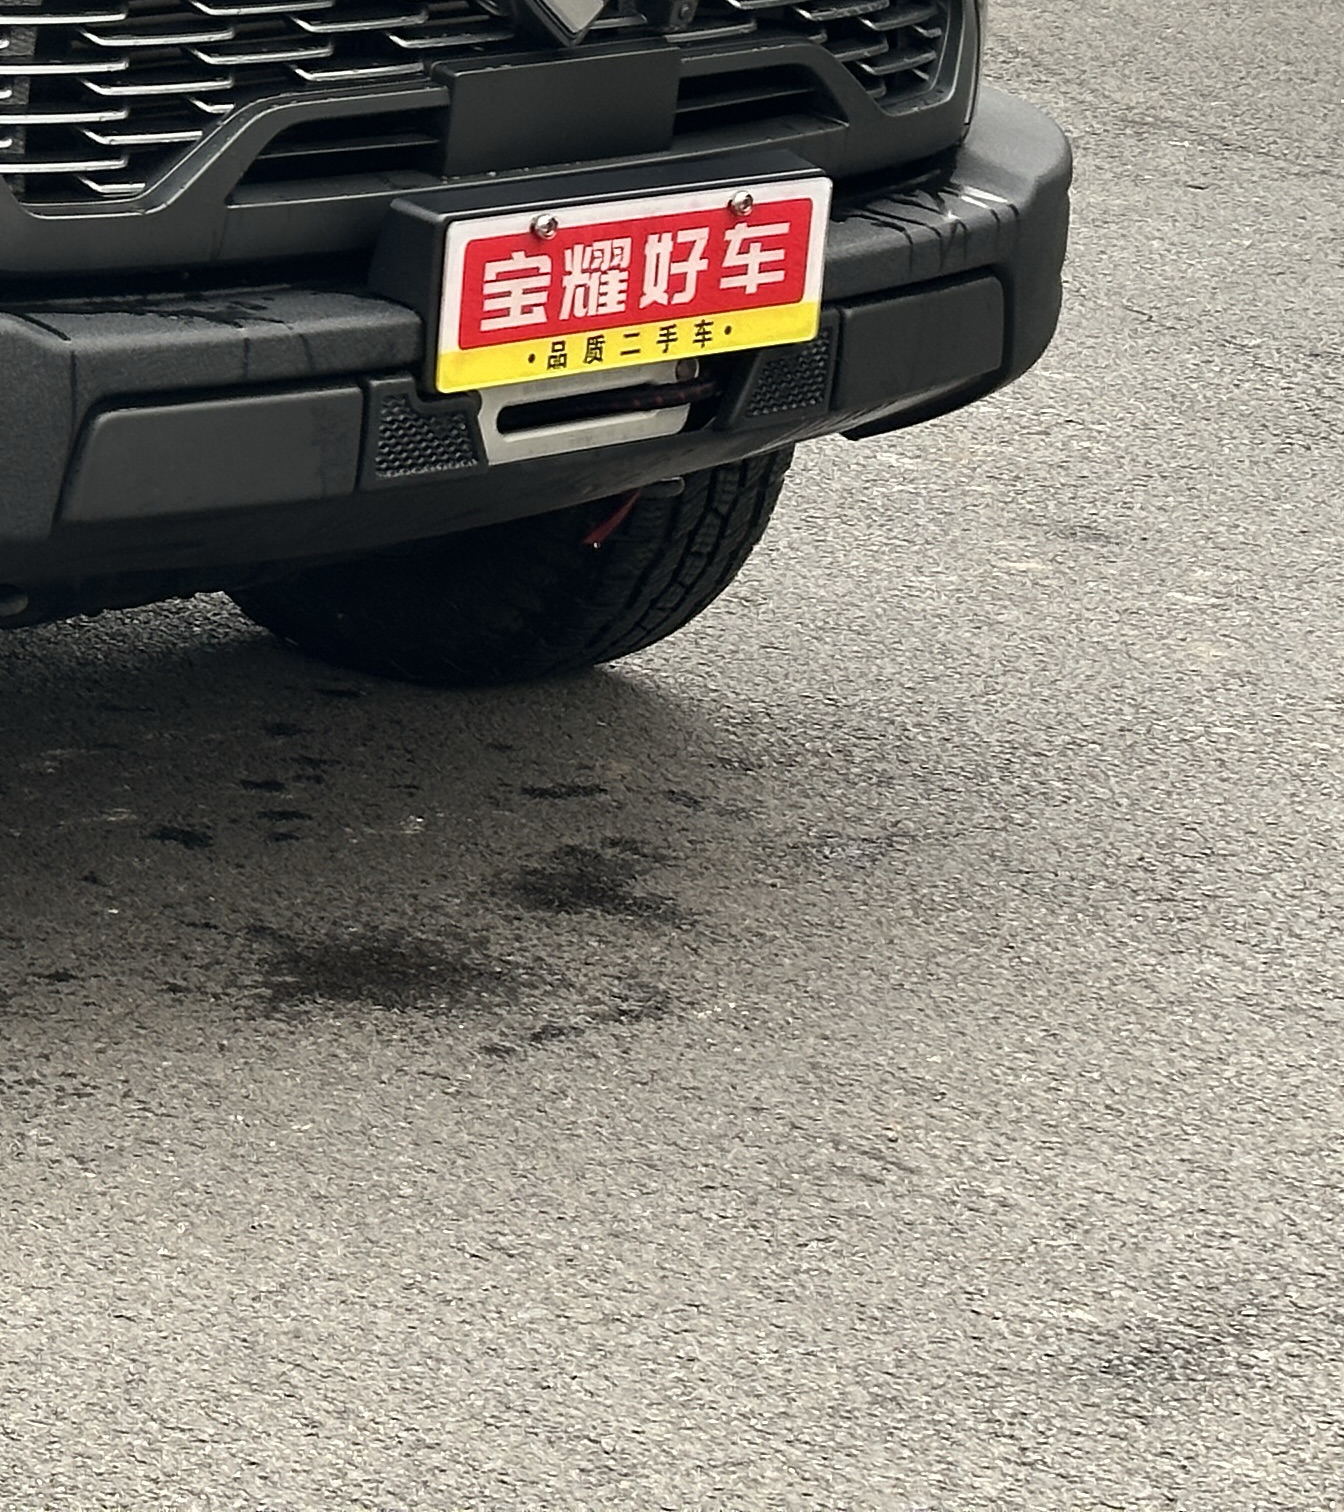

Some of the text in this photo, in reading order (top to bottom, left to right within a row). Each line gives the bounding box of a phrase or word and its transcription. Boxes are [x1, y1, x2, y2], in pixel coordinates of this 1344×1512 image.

[480, 220, 791, 332] 宝耀好车
[546, 319, 715, 371] 品质二手车
